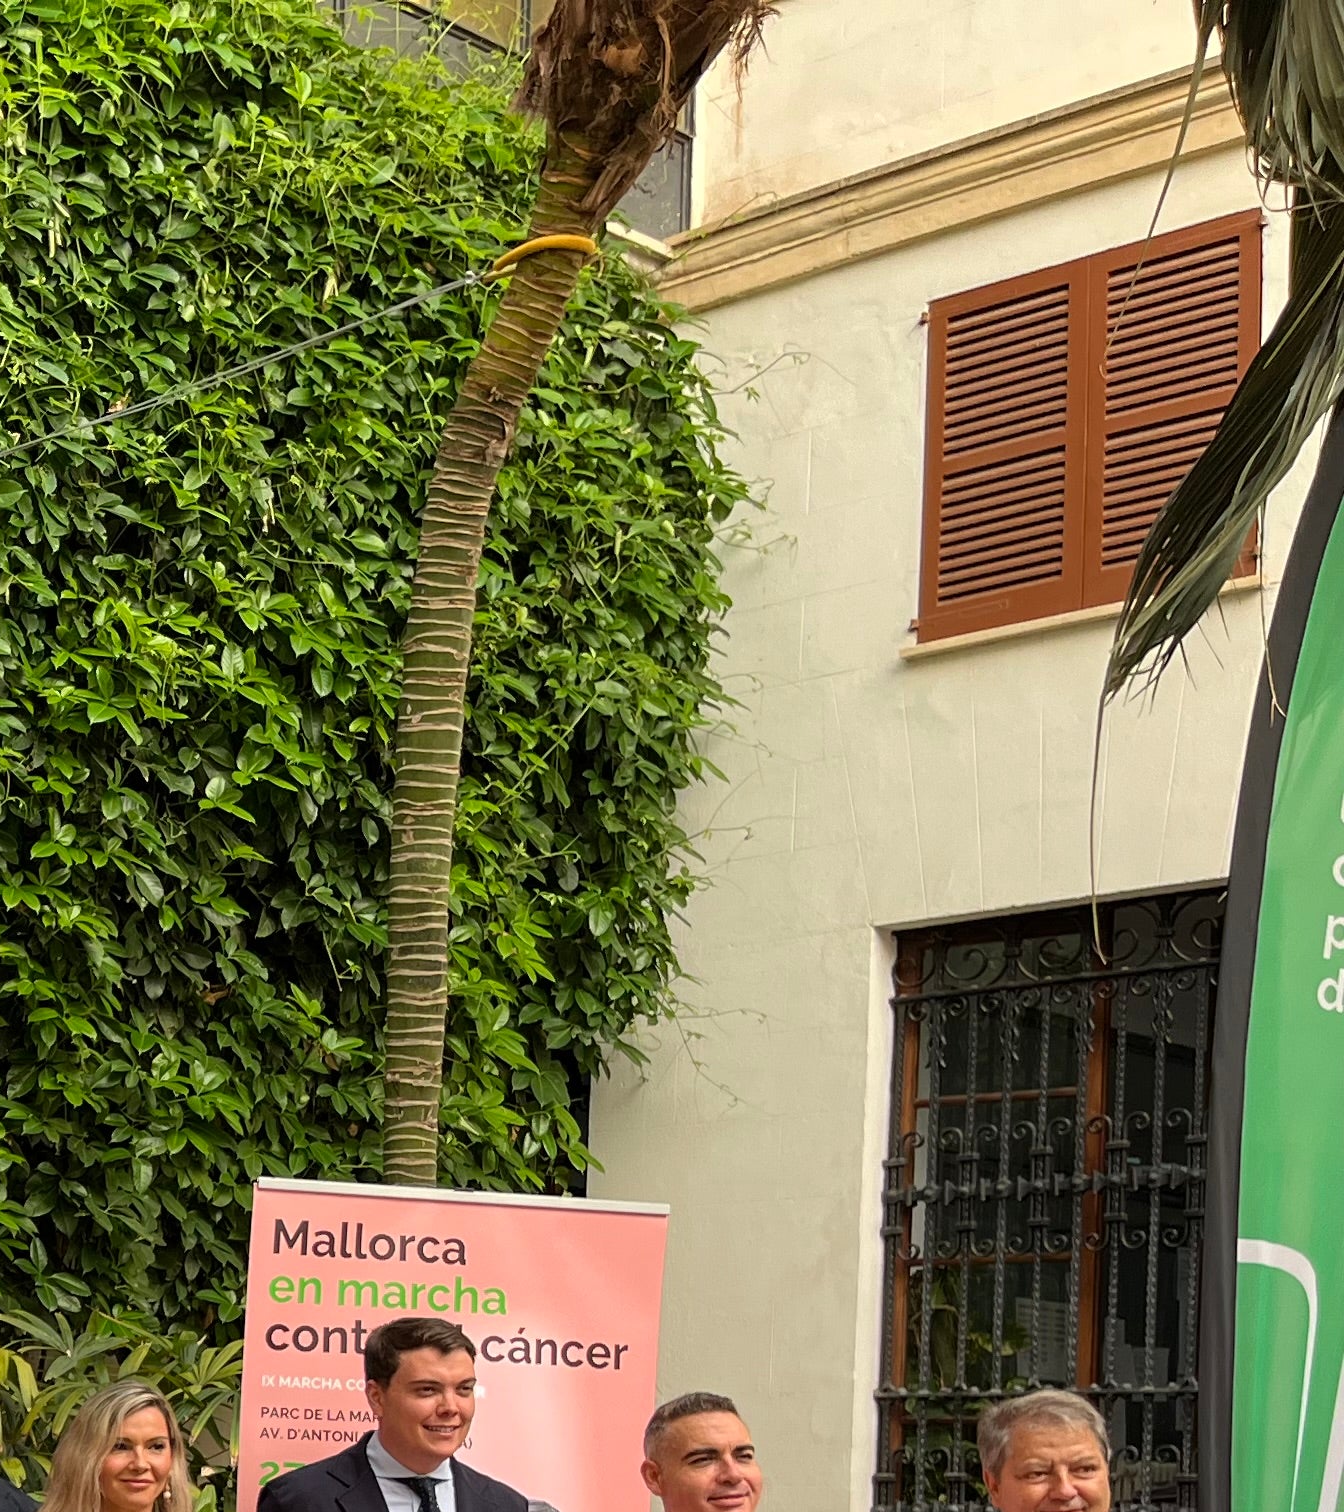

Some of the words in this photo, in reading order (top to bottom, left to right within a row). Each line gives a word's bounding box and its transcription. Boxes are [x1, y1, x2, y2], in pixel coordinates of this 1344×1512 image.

[272, 1218, 467, 1266] Mallorca
[268, 1275, 322, 1305] en
[337, 1276, 507, 1316] marcha
[265, 1320, 367, 1355] cont
[480, 1327, 628, 1371] cáncer
[262, 1375, 275, 1387] IX
[279, 1376, 342, 1390] MARCHA
[348, 1379, 366, 1392] CO
[260, 1407, 300, 1420] PARC
[304, 1407, 323, 1421] DE
[327, 1408, 345, 1422] LA
[287, 1428, 358, 1443] D'ANTONI
